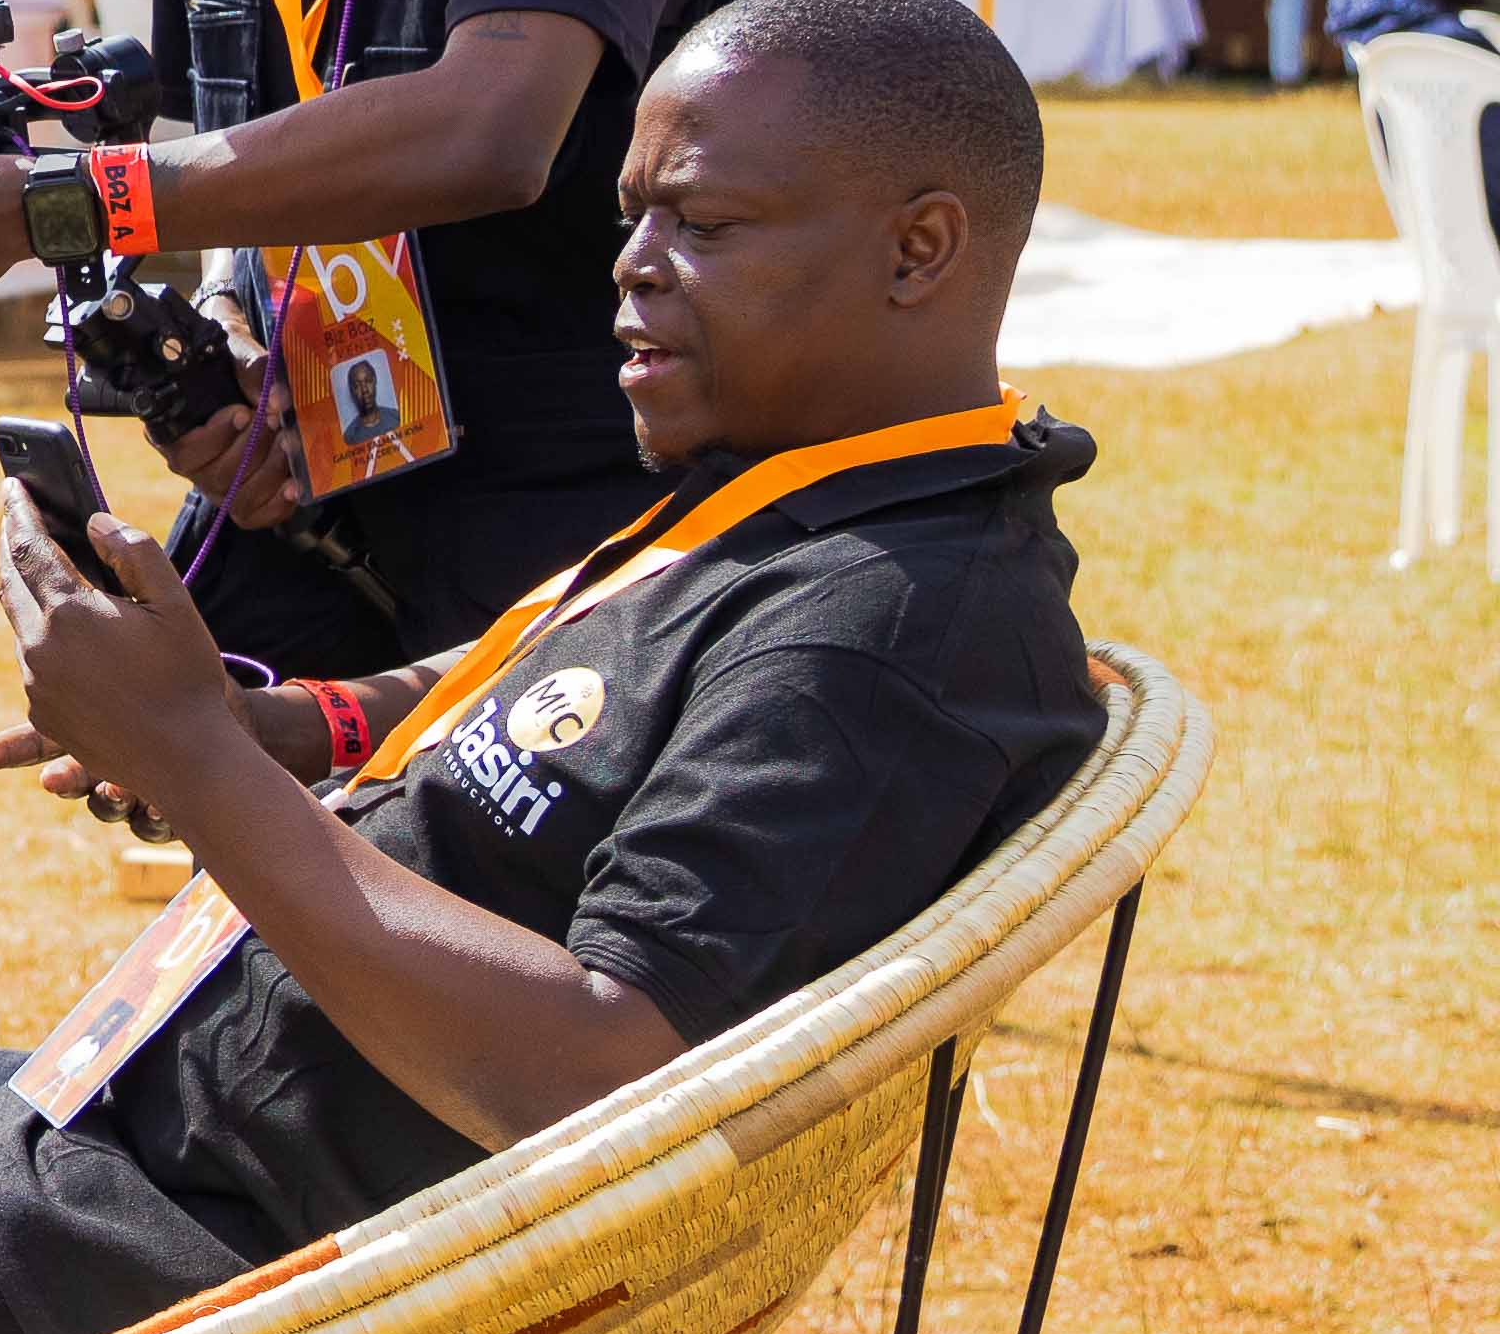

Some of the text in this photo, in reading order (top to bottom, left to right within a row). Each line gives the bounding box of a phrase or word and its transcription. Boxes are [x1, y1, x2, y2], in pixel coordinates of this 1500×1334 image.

[105, 166, 132, 215] BAZ
[443, 749, 514, 837] PRODUCTION
[451, 697, 562, 836] Jasiri
